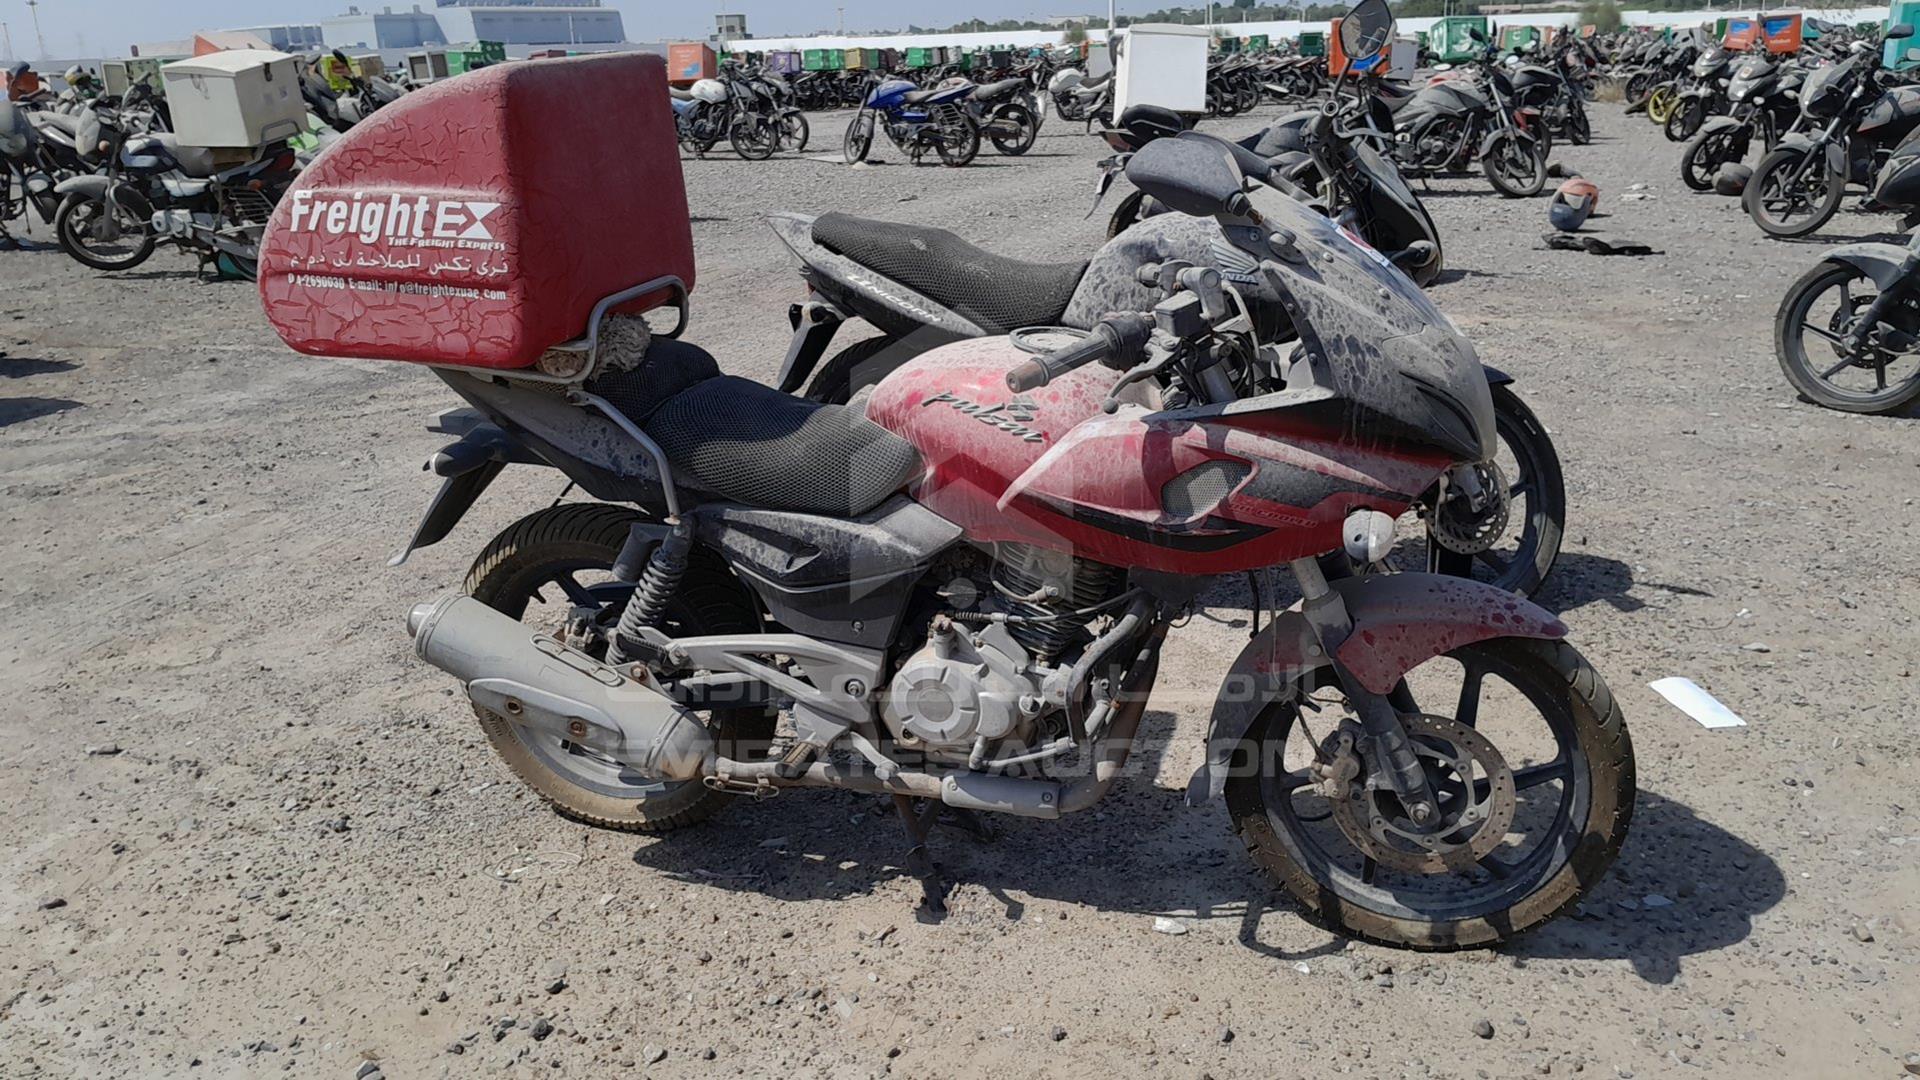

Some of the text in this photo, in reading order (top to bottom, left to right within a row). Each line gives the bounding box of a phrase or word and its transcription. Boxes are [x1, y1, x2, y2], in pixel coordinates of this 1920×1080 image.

[388, 236, 506, 251] THE FREIGHT EXPRESS
[348, 277, 383, 293] E-mail:
[1220, 272, 1258, 284] NDA
